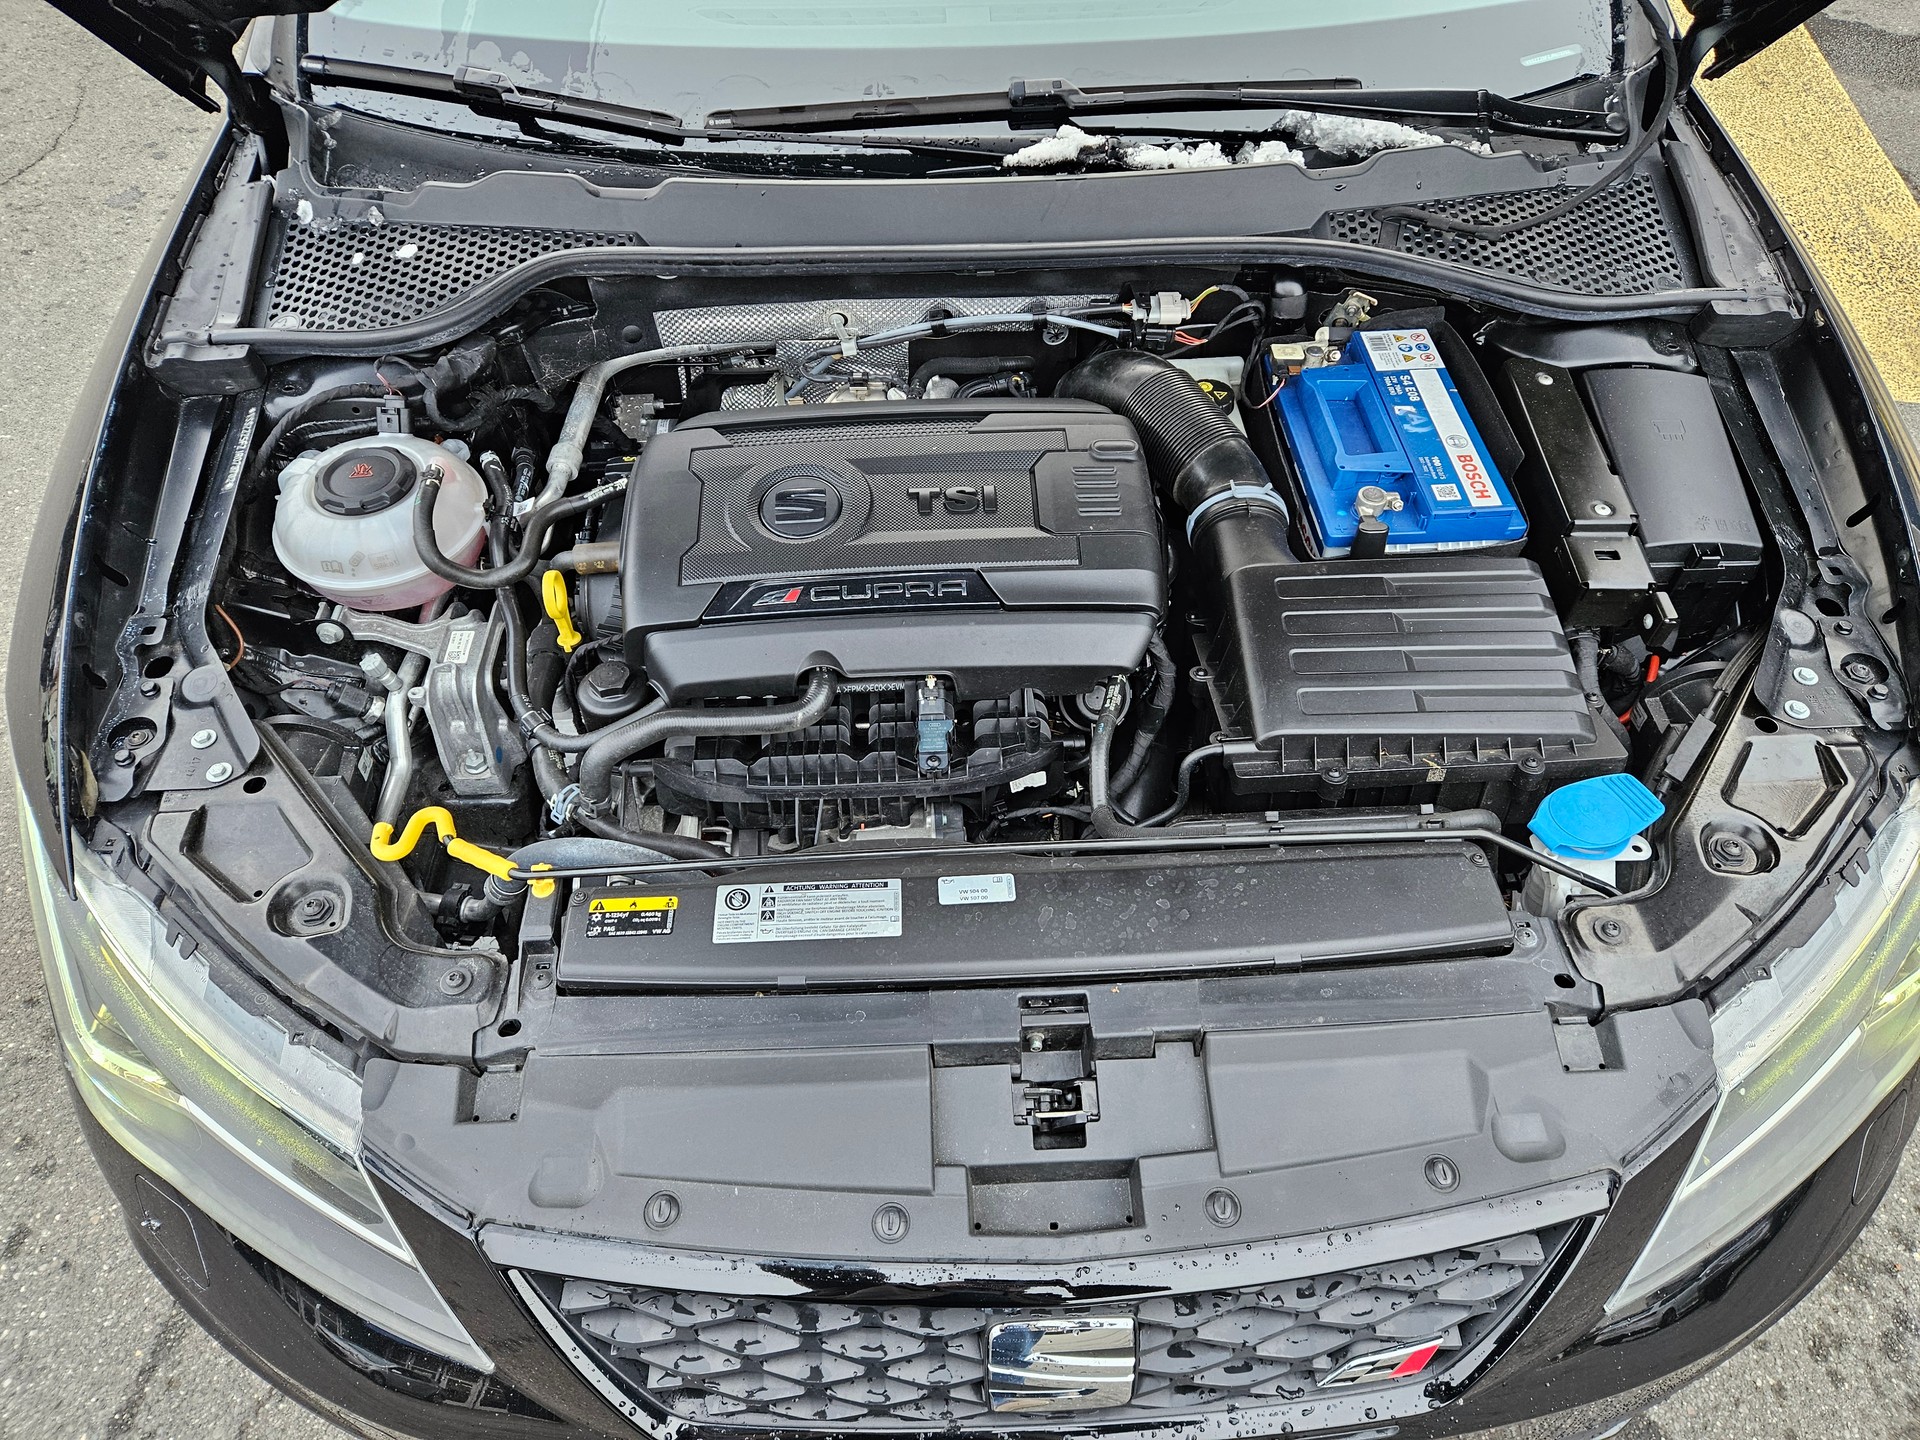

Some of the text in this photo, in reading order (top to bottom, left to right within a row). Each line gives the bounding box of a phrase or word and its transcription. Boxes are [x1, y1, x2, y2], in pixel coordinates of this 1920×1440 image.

[1400, 375, 1420, 402] S4 E08
[1456, 454, 1492, 499] BOSCH
[907, 485, 999, 516] TSI
[810, 580, 968, 603] CUPRA
